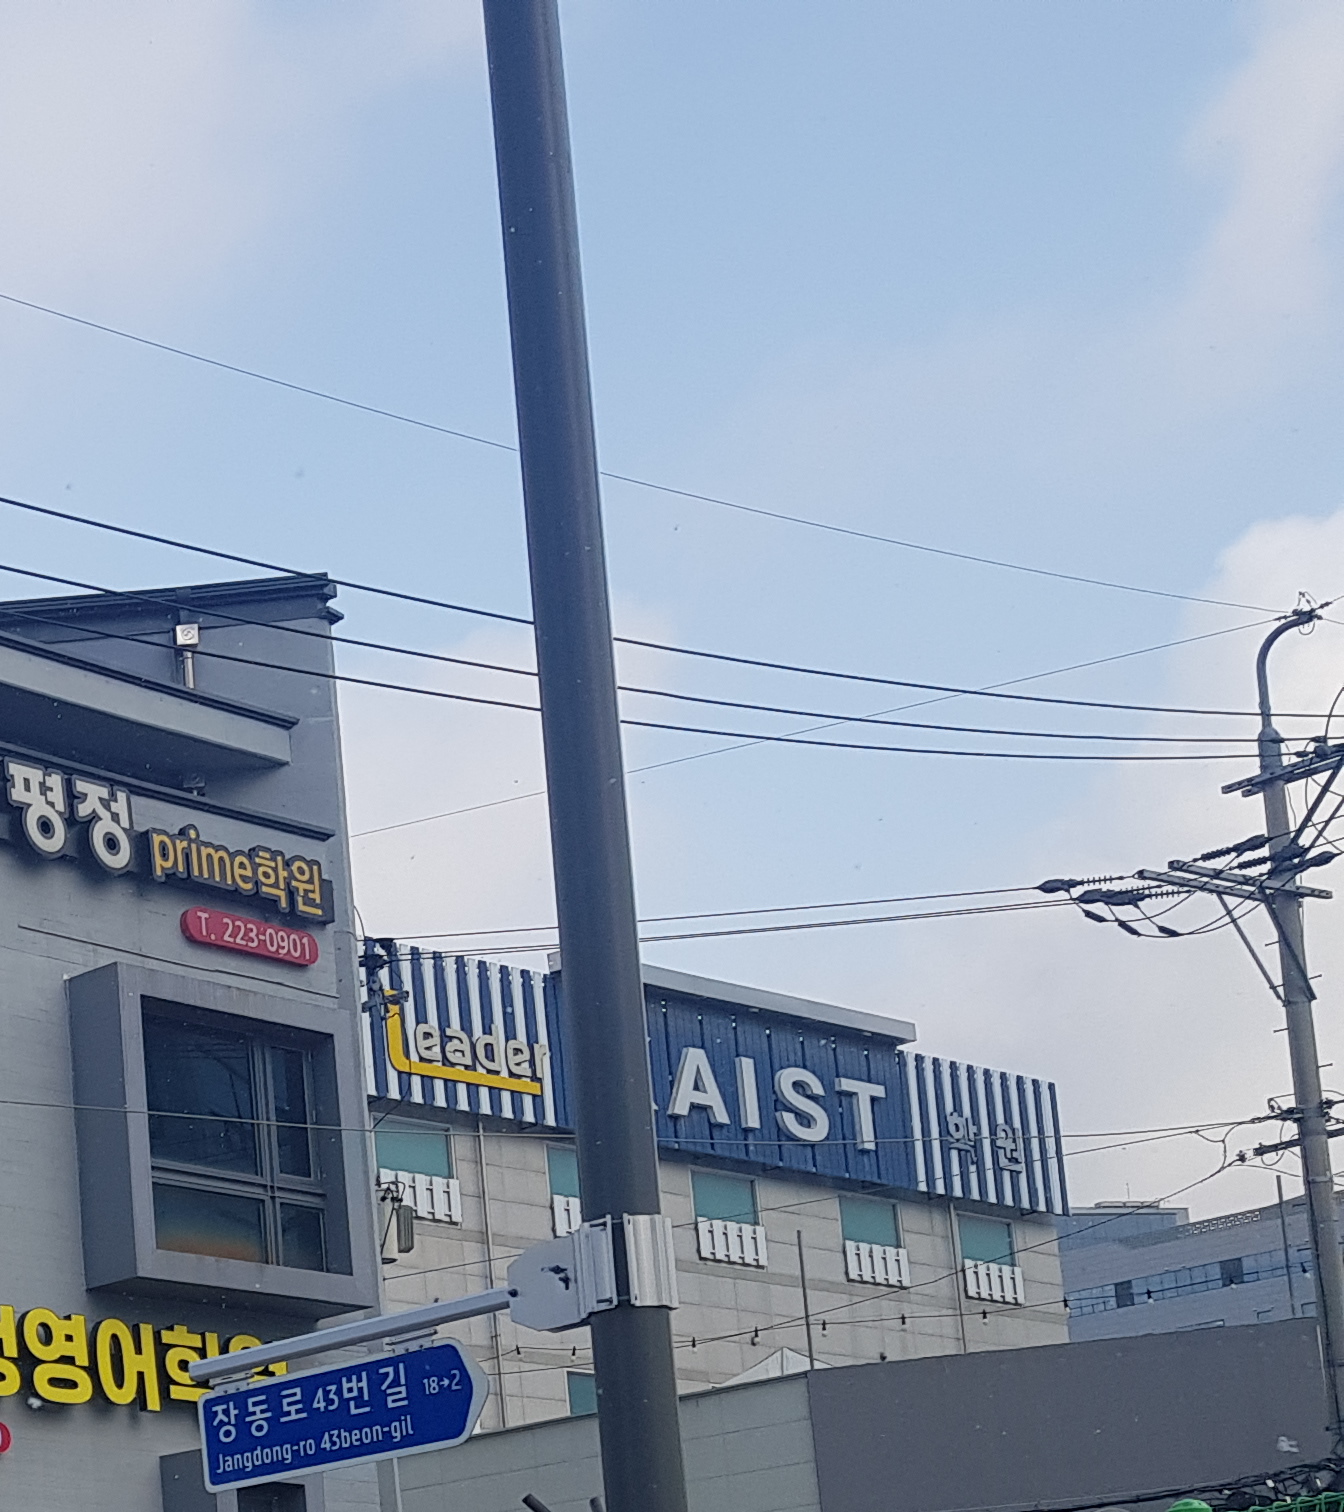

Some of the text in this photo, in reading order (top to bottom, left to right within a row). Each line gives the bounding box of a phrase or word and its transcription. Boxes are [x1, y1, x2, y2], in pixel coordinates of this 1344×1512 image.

[152, 825, 324, 920] prime학원
[222, 917, 312, 961] 223-0901
[383, 988, 548, 1096] Leader
[650, 1045, 886, 1152] AIST
[212, 1386, 308, 1443] 장동로
[312, 1362, 409, 1415] 43번길
[216, 1415, 414, 1474] Jangdong-ro 43beon-gil
